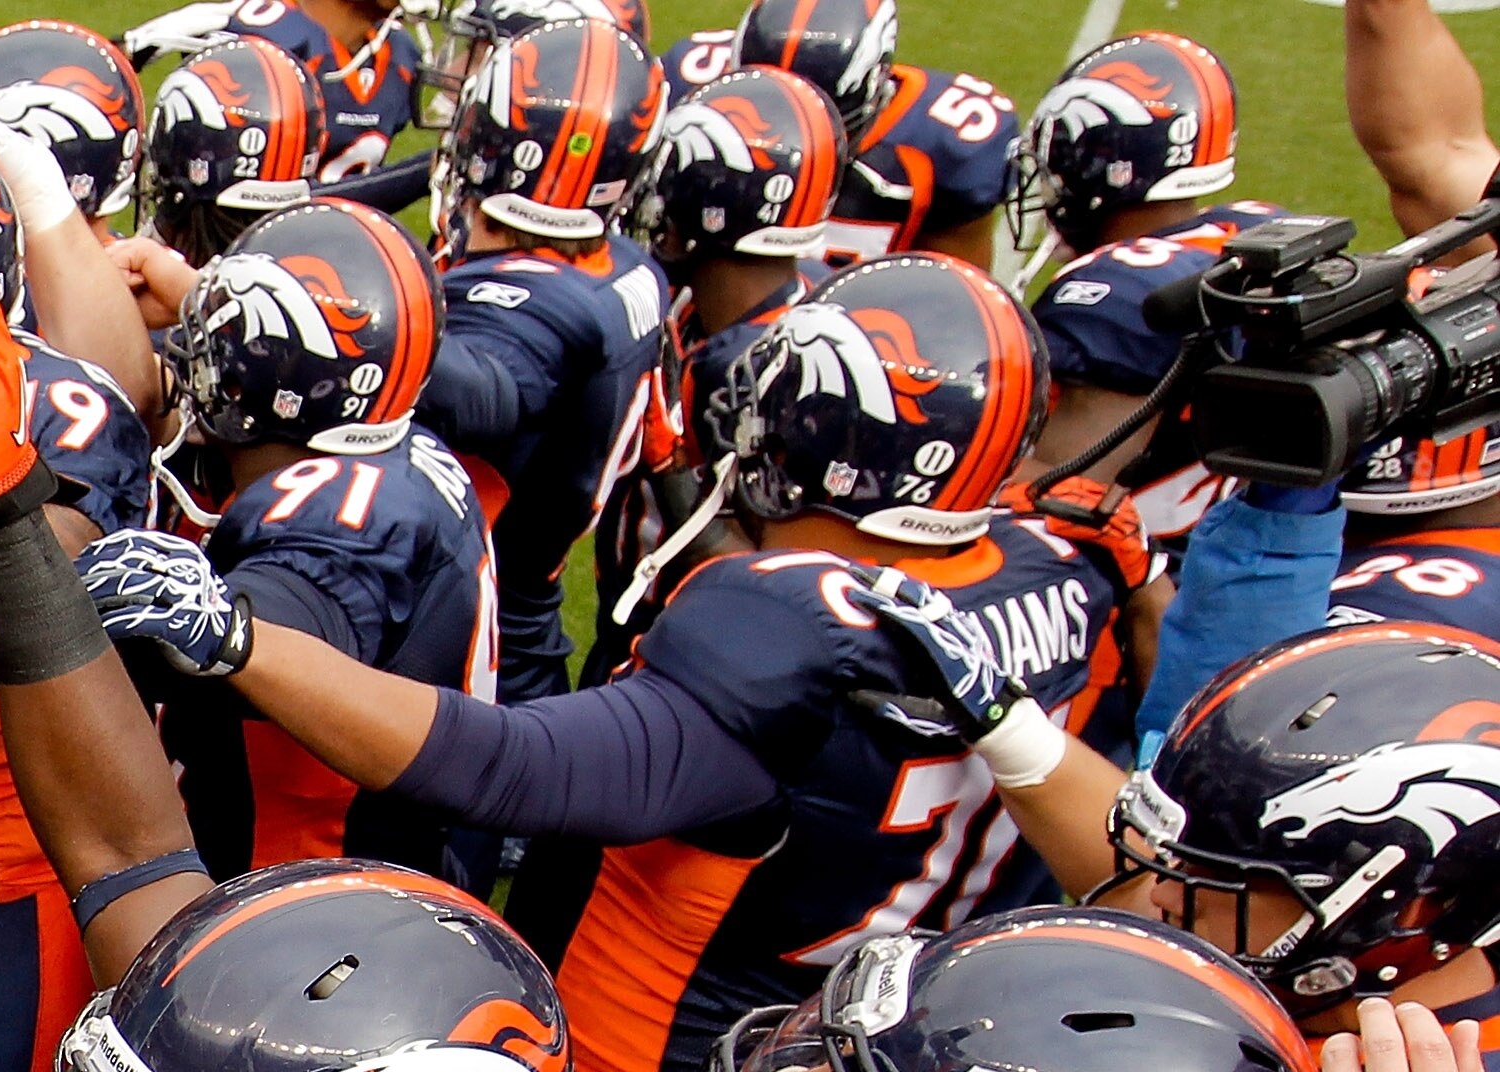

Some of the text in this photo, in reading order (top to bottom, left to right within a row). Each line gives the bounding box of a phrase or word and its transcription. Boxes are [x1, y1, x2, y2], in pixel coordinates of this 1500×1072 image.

[232, 157, 258, 178] 22
[340, 397, 370, 419] 91
[1366, 457, 1404, 480] 28
[264, 457, 383, 531] 91
[895, 474, 936, 504] 76
